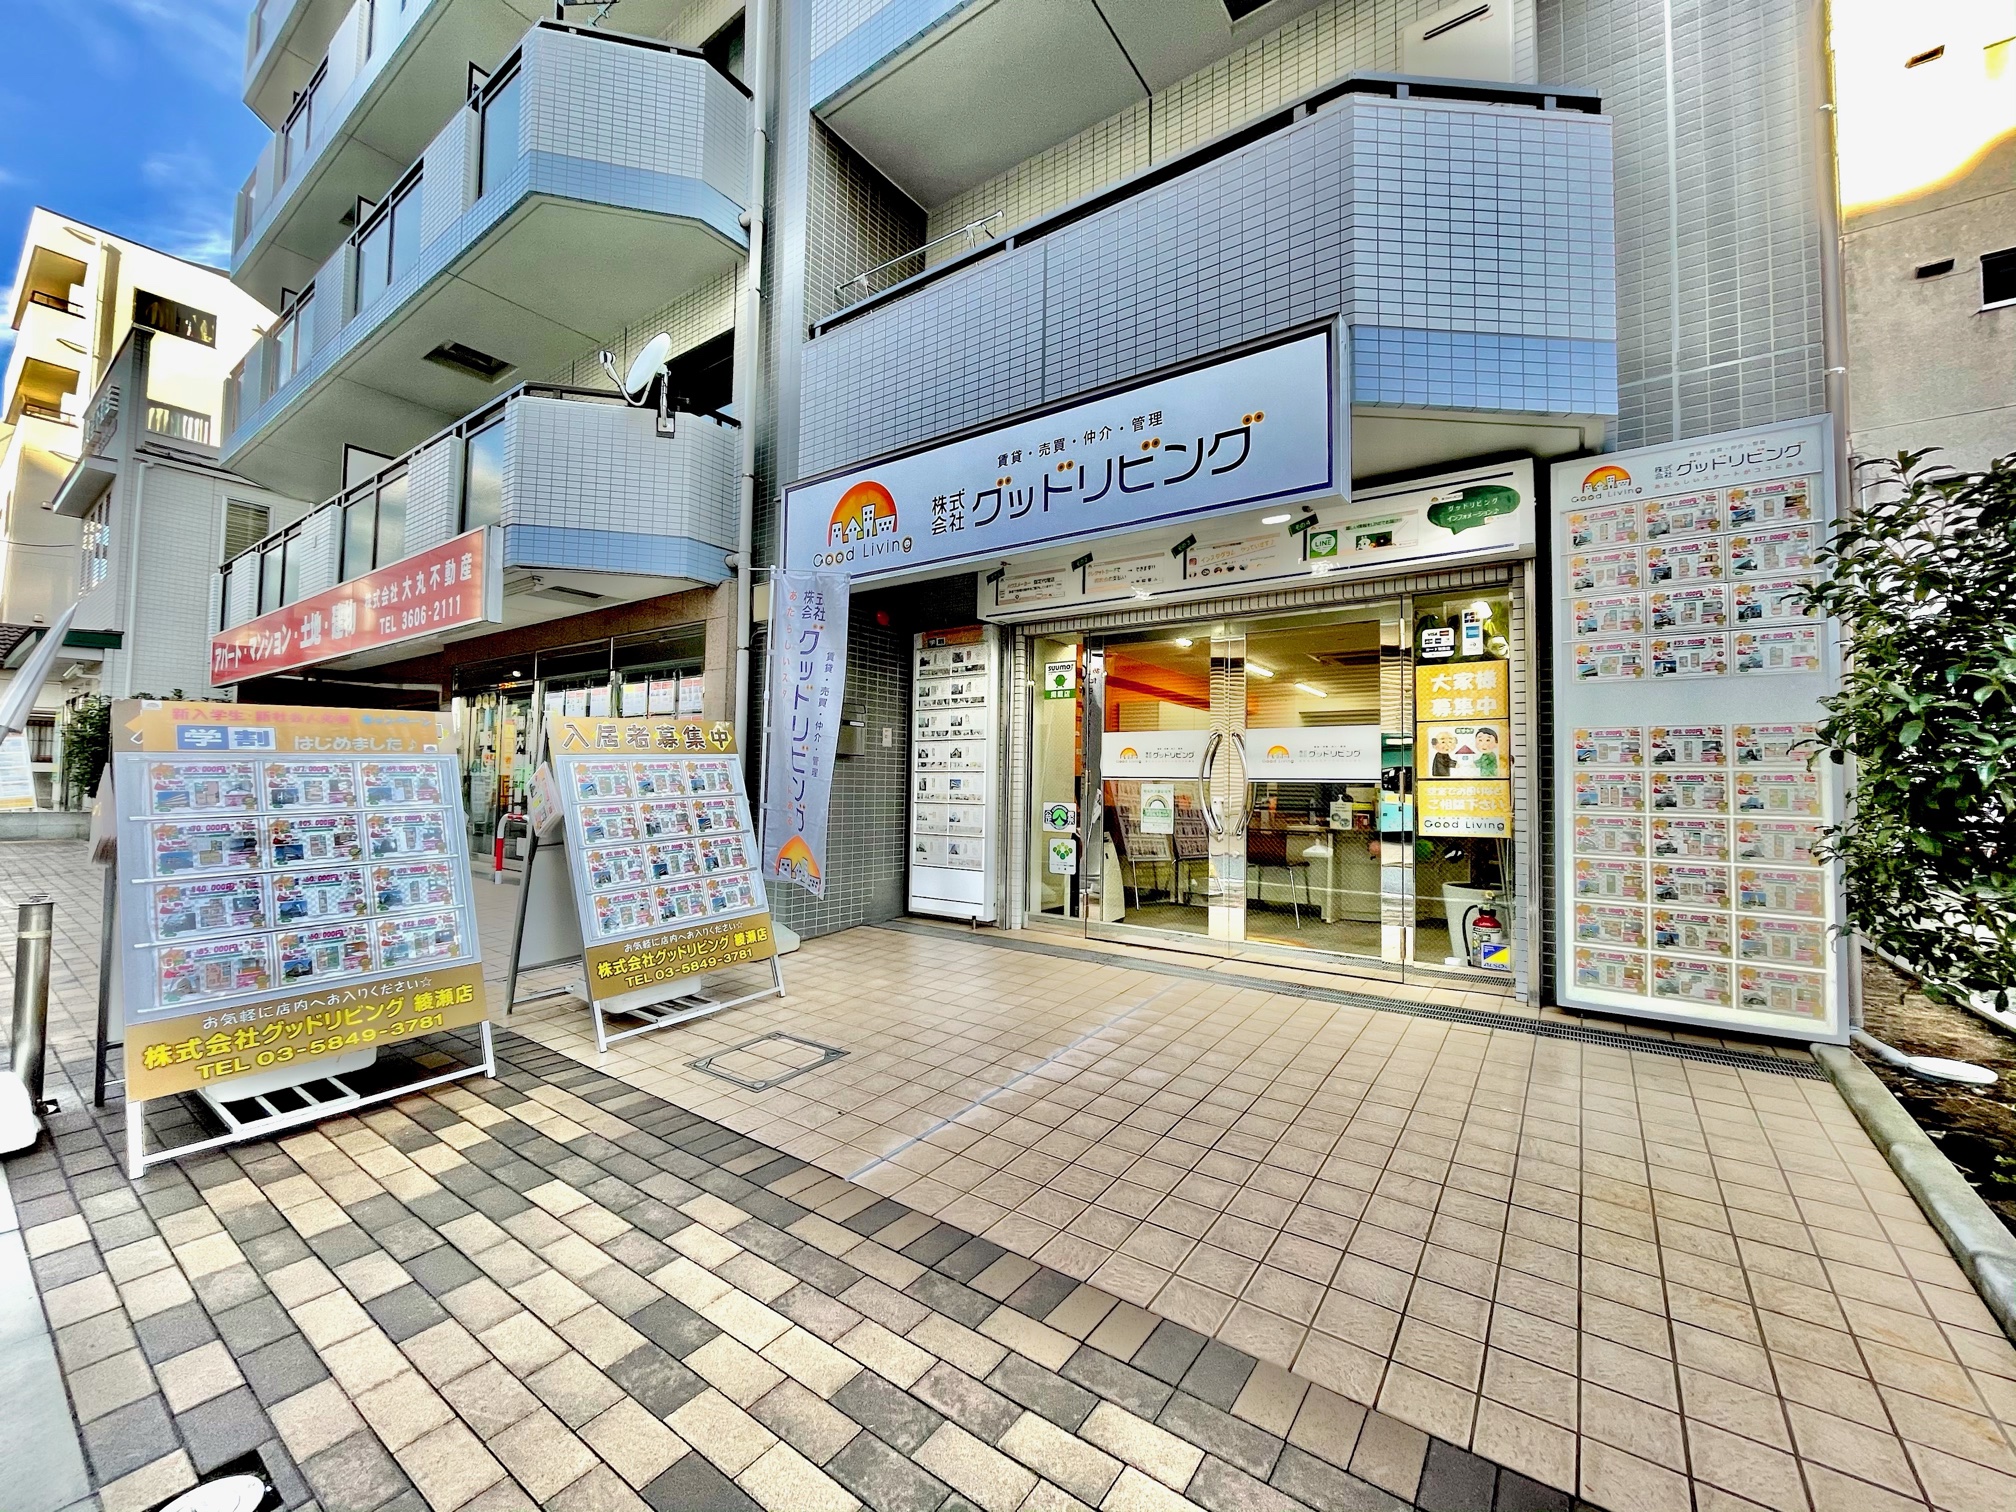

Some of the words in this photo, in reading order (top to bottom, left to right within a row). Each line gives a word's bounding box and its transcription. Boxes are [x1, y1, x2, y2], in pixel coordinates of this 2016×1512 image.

[973, 411, 1265, 527] グッドリビング
[1676, 440, 1807, 477] グッドリビング
[1447, 497, 1499, 513] グッドリビング
[1571, 493, 1602, 504] Good
[1607, 486, 1643, 499] Living
[812, 545, 856, 568] Good
[863, 536, 913, 558] Living
[1314, 538, 1332, 548] LINE
[401, 552, 473, 602] 大丸不動産
[379, 615, 397, 635] TEL
[1430, 670, 1497, 693] 大家様
[184, 729, 272, 749] 学割
[294, 734, 403, 751] はじめました
[562, 723, 730, 751] 入居者募集中
[791, 623, 825, 833] グッドリビング
[1424, 819, 1459, 829] Good
[1465, 820, 1505, 832] Living
[597, 935, 729, 979] 株式会社グッドリビング
[625, 974, 653, 988] TEL
[655, 948, 753, 980] 03-5849-3781
[142, 996, 404, 1070] 株式会社グッドリビング
[196, 1057, 251, 1080] TEL
[257, 1013, 444, 1067] 03-5849-3781
